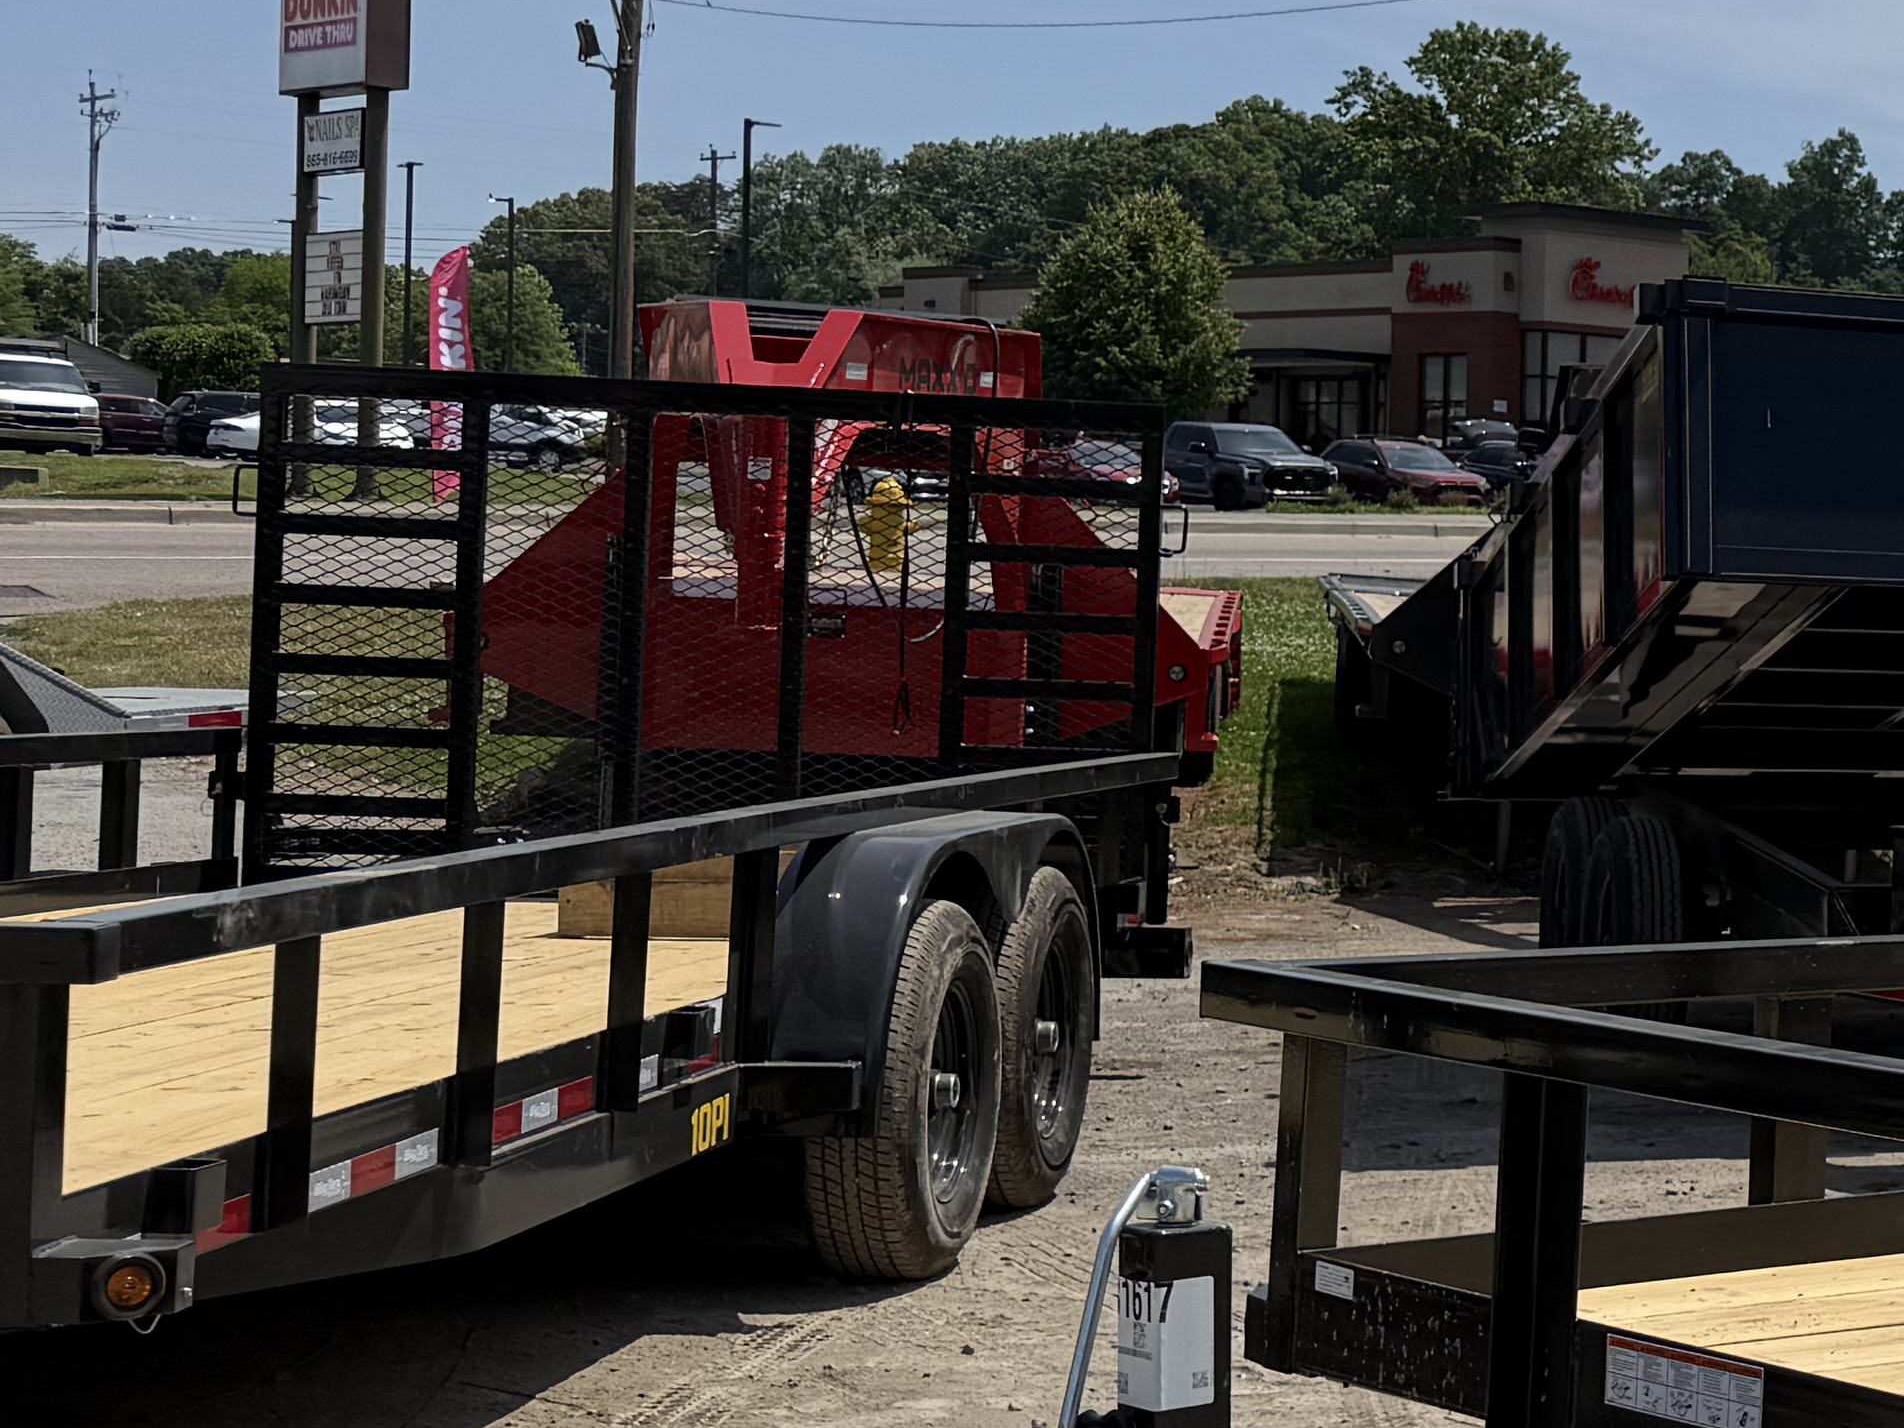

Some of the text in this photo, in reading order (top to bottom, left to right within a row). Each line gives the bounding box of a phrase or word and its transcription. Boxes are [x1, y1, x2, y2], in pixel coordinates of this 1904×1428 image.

[289, 22, 354, 49] DRIVE THRU
[691, 1092, 730, 1156] 10PI
